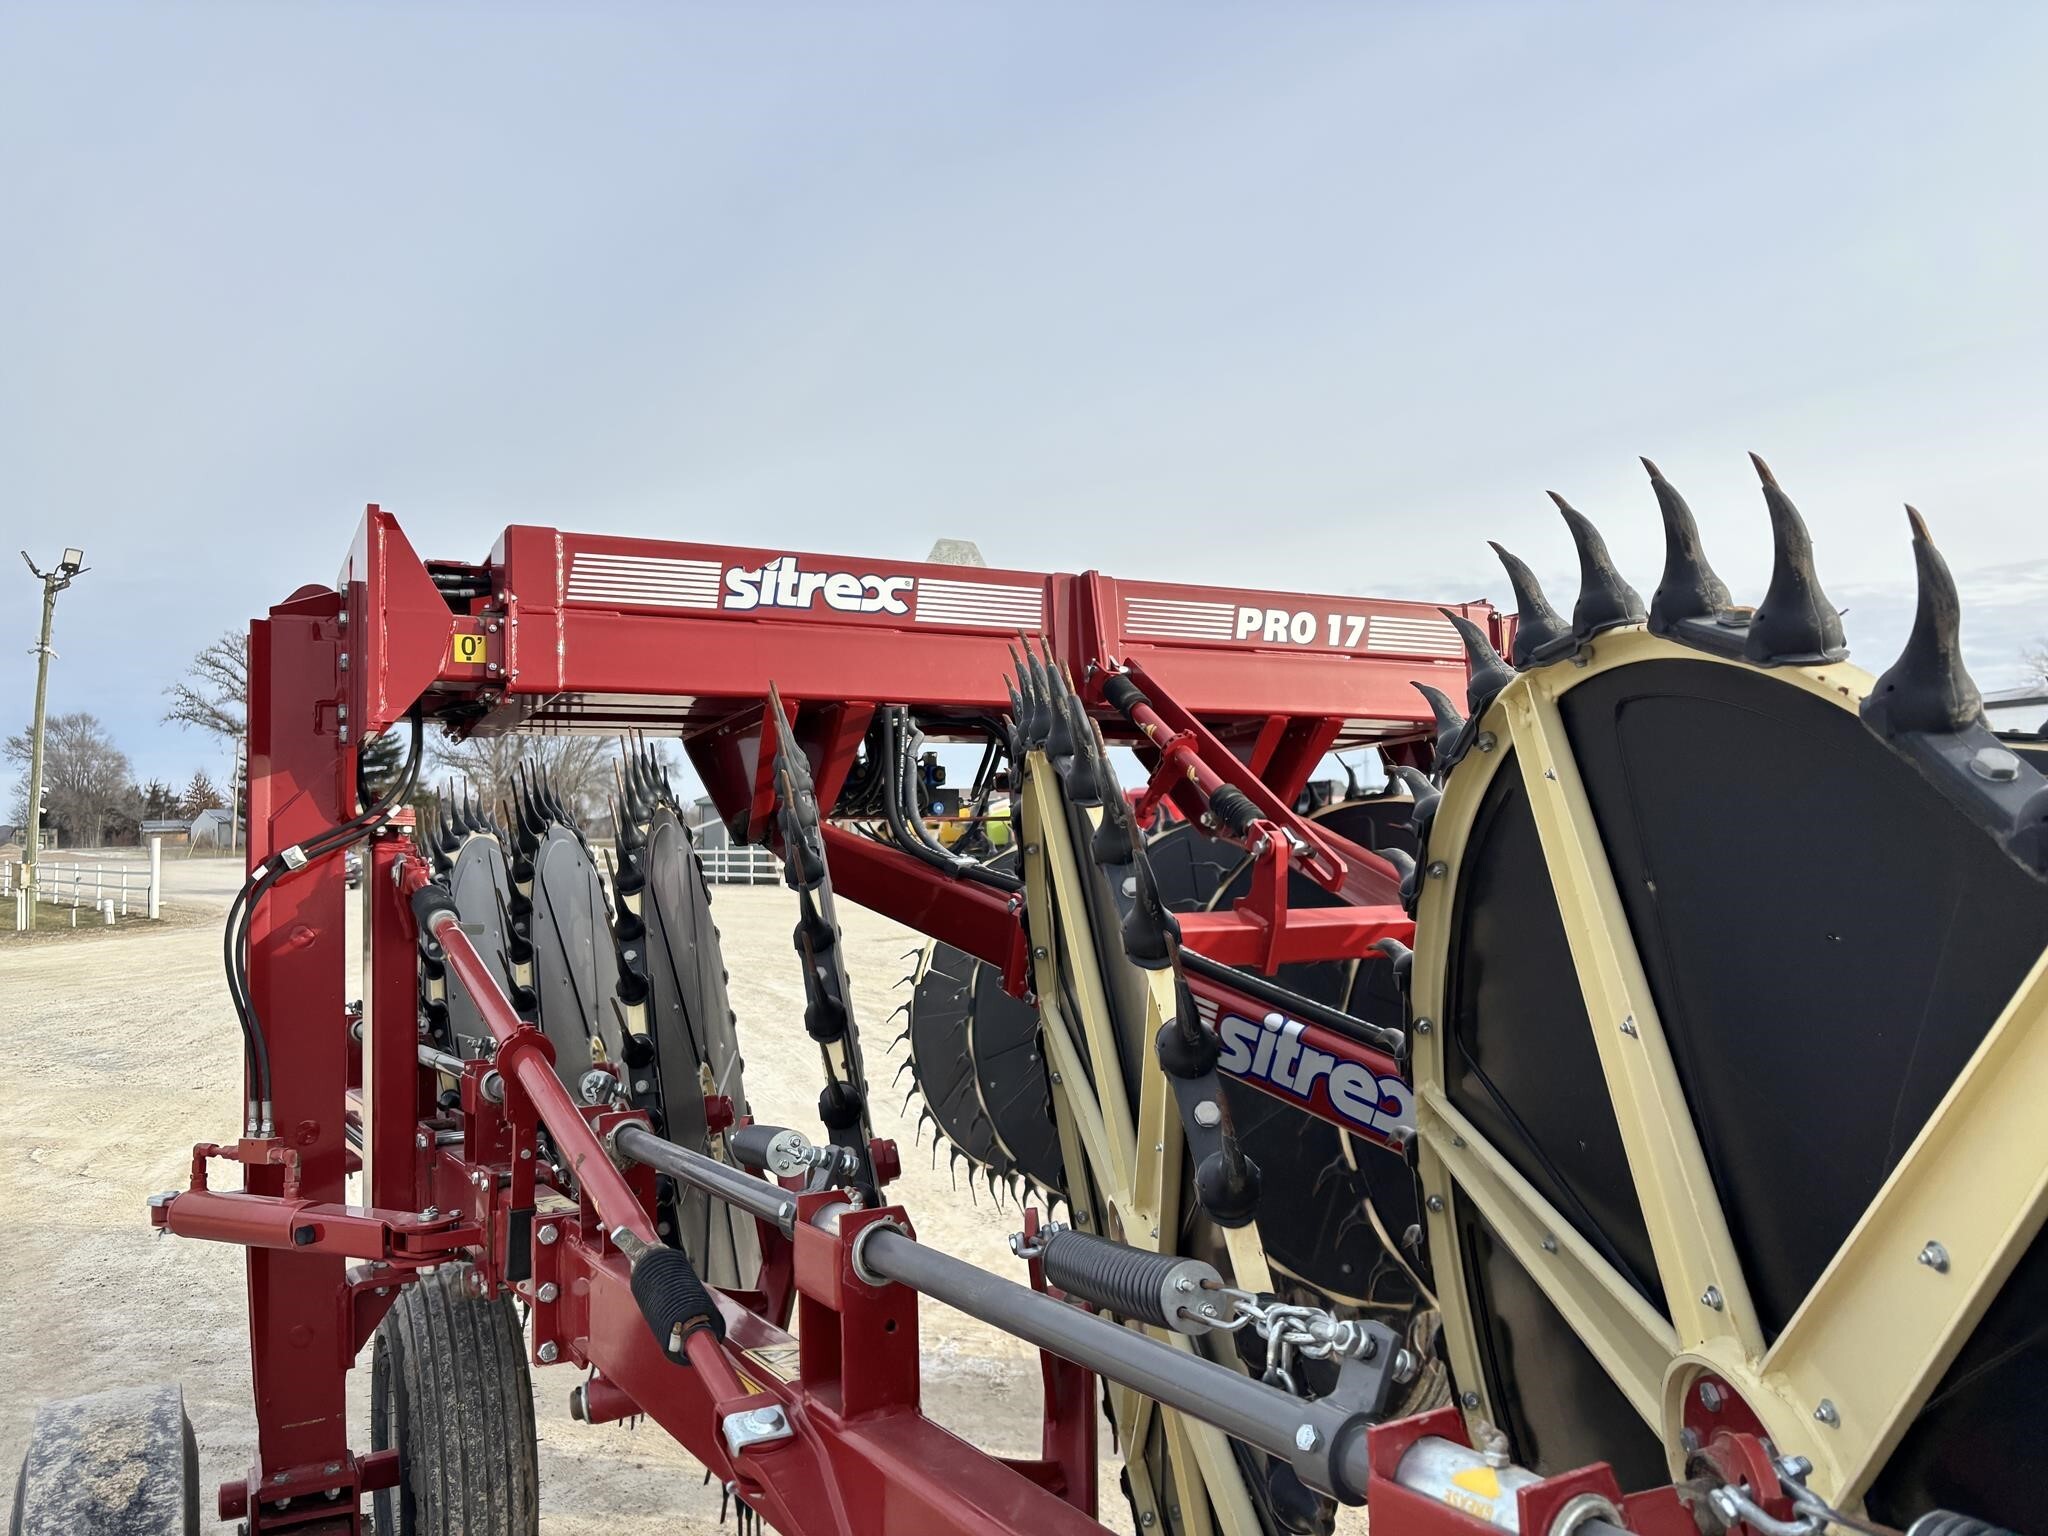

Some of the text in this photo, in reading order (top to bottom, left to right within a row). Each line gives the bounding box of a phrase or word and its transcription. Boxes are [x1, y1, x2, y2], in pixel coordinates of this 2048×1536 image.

[723, 555, 915, 616] sitrex
[1236, 606, 1366, 648] PRO 17
